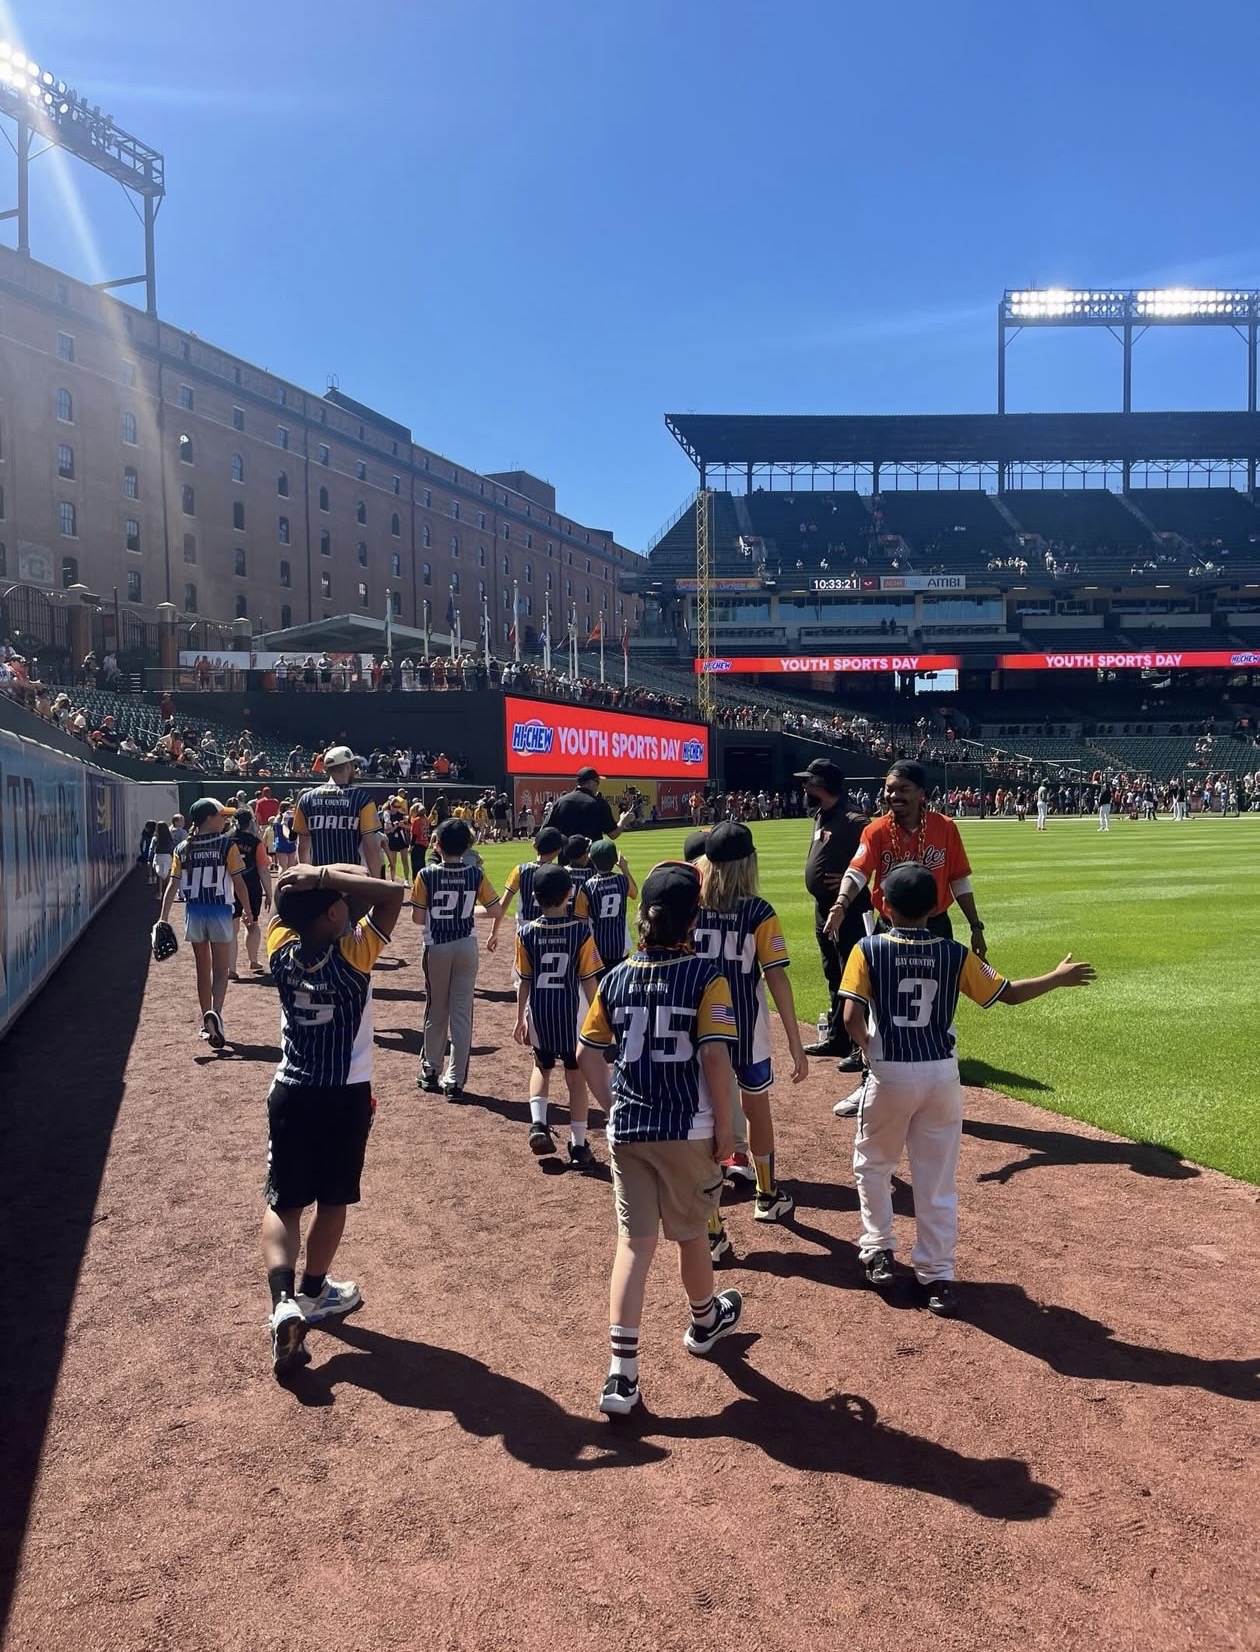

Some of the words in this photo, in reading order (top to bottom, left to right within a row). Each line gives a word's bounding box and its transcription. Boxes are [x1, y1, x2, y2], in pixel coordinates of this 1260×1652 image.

[814, 579, 857, 589] 10:33:21
[927, 578, 960, 588] AMBI
[780, 659, 830, 671] YOUTH
[833, 658, 889, 670] SPORTS
[892, 657, 919, 670] DAY
[1045, 656, 1094, 668] YOUTH
[1097, 655, 1152, 668] SPORTS
[1156, 655, 1183, 666] DAY
[557, 727, 608, 757] YOUTH
[612, 733, 658, 760] SPORTS
[660, 738, 681, 761] DAY
[311, 799, 323, 807] BAY
[325, 799, 350, 807] COUNTRY
[193, 851, 221, 860] COUNTRY
[180, 865, 225, 899] 44
[431, 890, 477, 919] 21
[599, 893, 621, 918] 8
[895, 957, 908, 967] BAY
[909, 958, 936, 968] COUNTRY
[536, 952, 569, 989] 2
[628, 983, 642, 994] BAY
[293, 990, 337, 1027] 5
[892, 977, 939, 1028] 3
